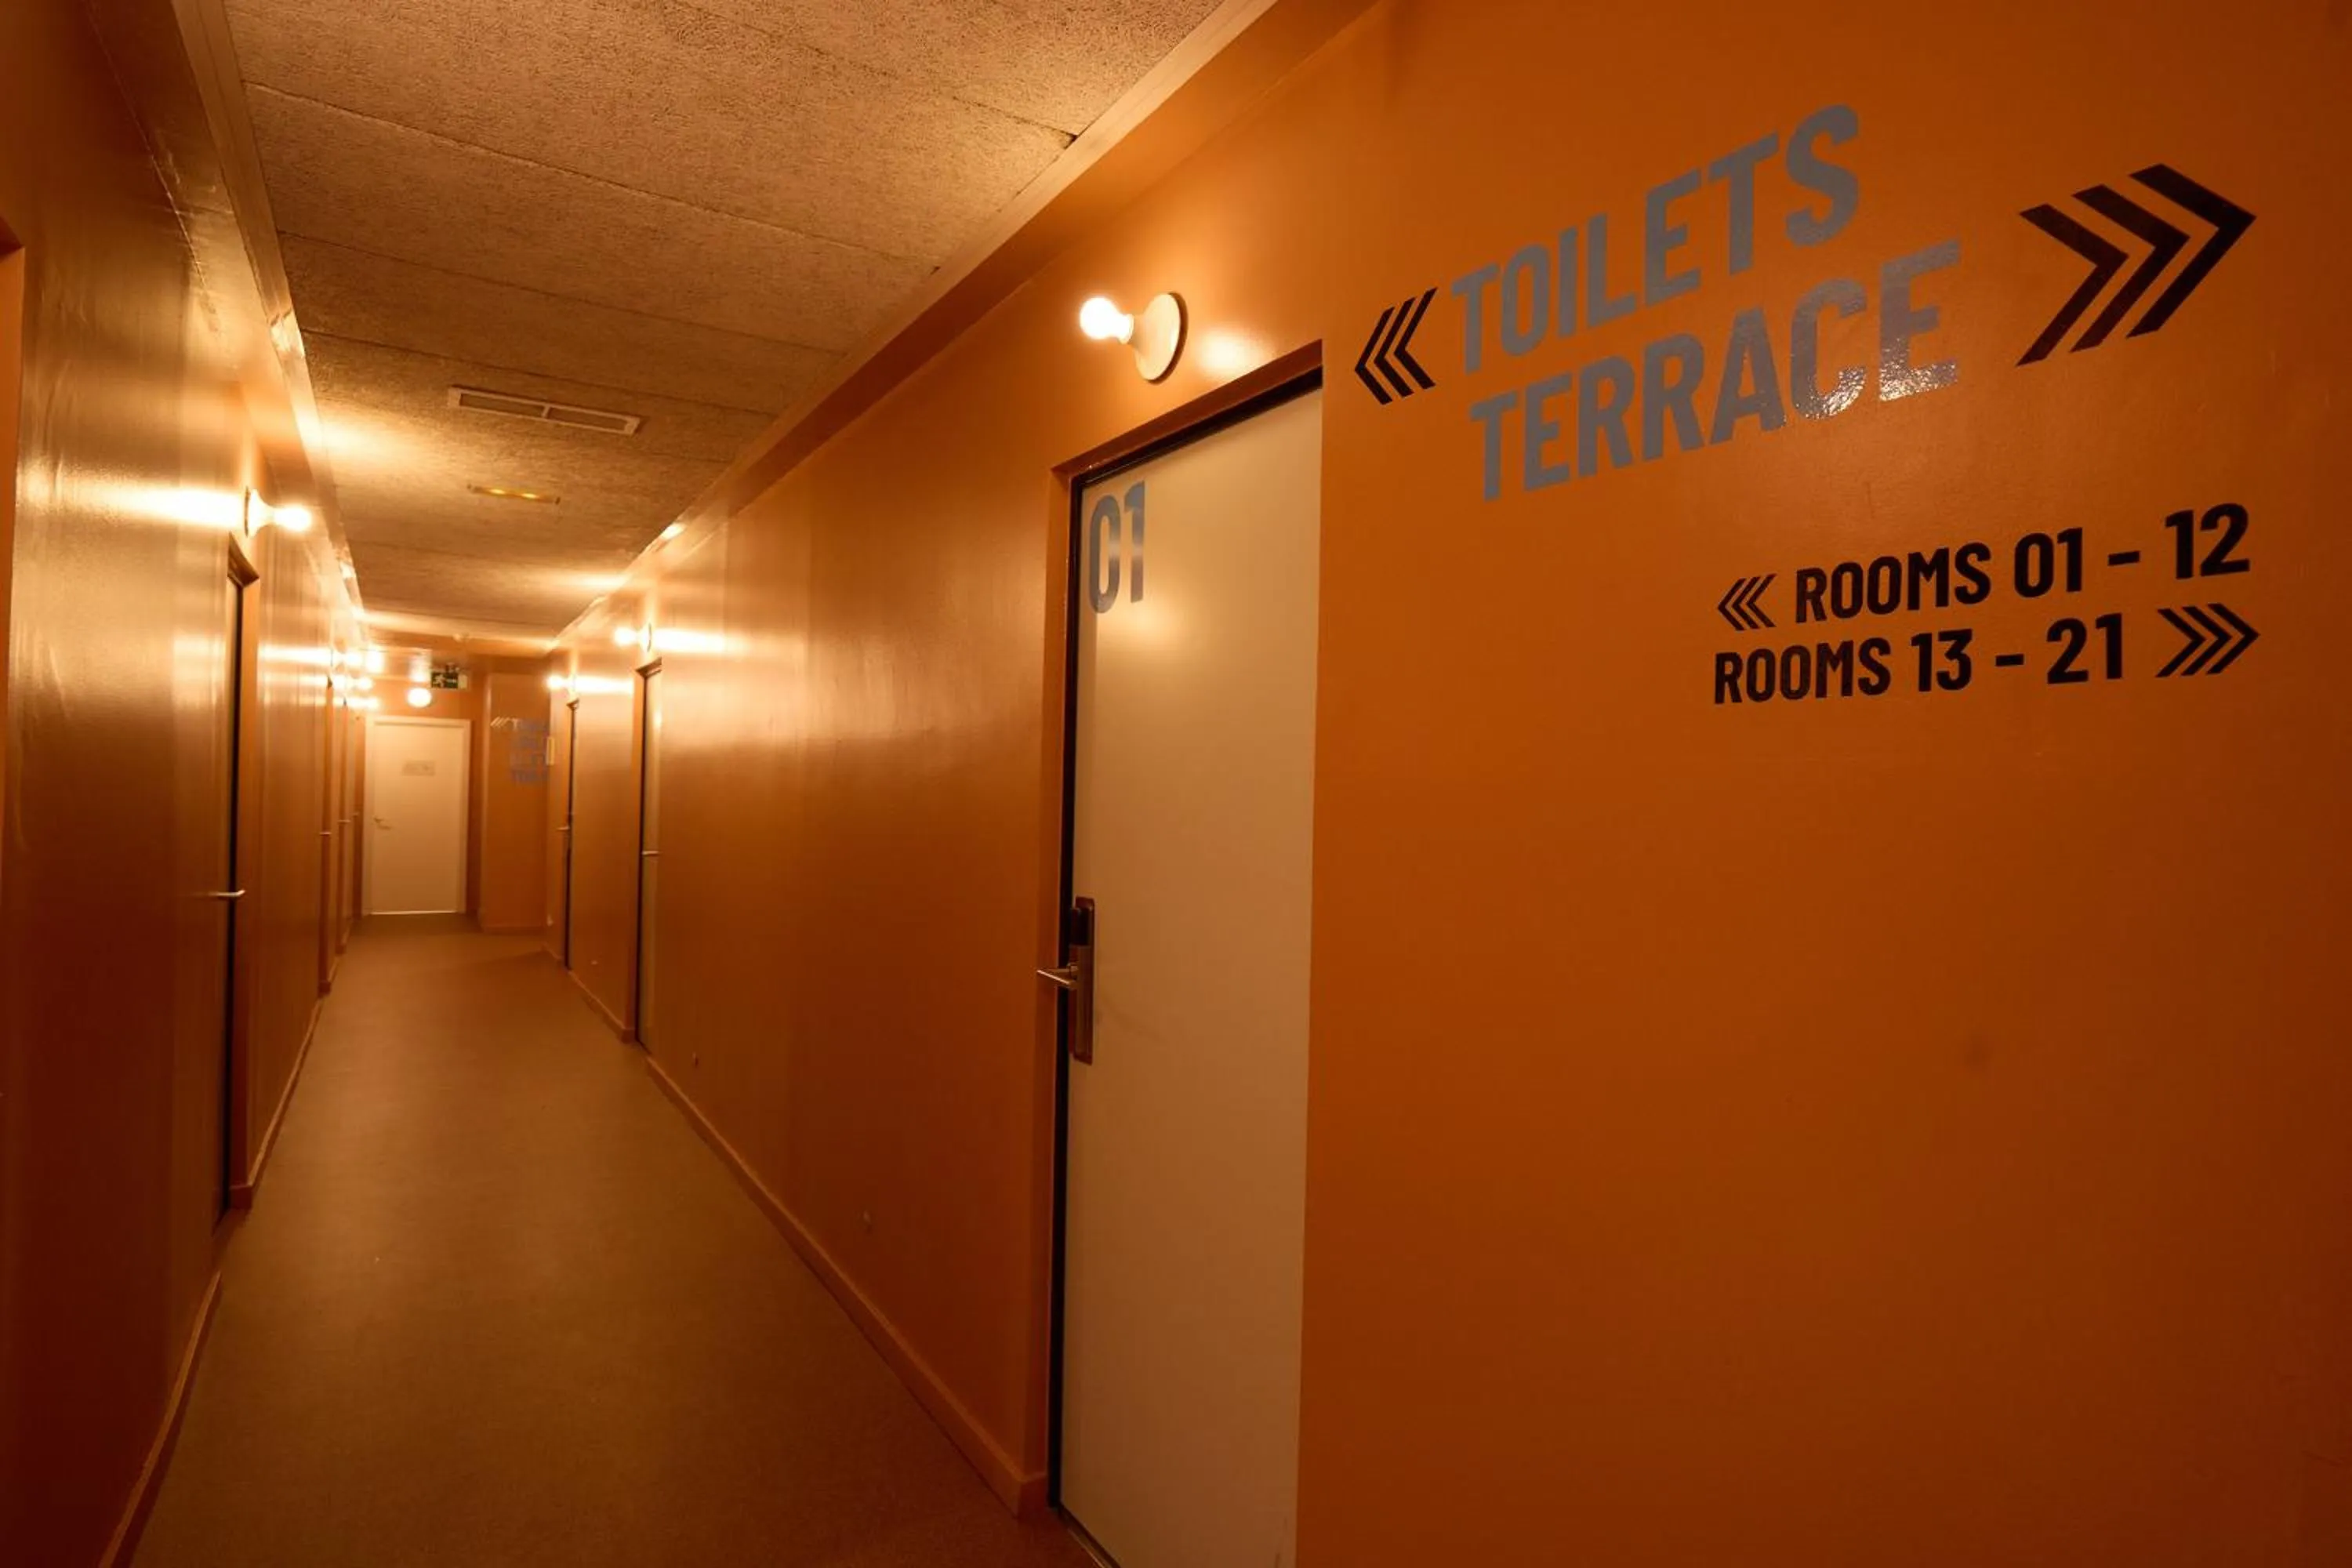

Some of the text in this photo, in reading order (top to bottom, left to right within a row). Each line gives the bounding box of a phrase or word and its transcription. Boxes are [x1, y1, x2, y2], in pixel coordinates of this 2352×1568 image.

[1451, 103, 1860, 375] TOILETS
[1469, 238, 1960, 502] TERRACE
[1089, 480, 1145, 614] 01
[1795, 541, 1991, 624] ROOMS
[2014, 527, 2083, 598] 01
[2164, 503, 2250, 580] 12
[1714, 637, 1891, 705] ROOMS
[1911, 629, 1973, 692] 13
[2046, 613, 2122, 684] 21
